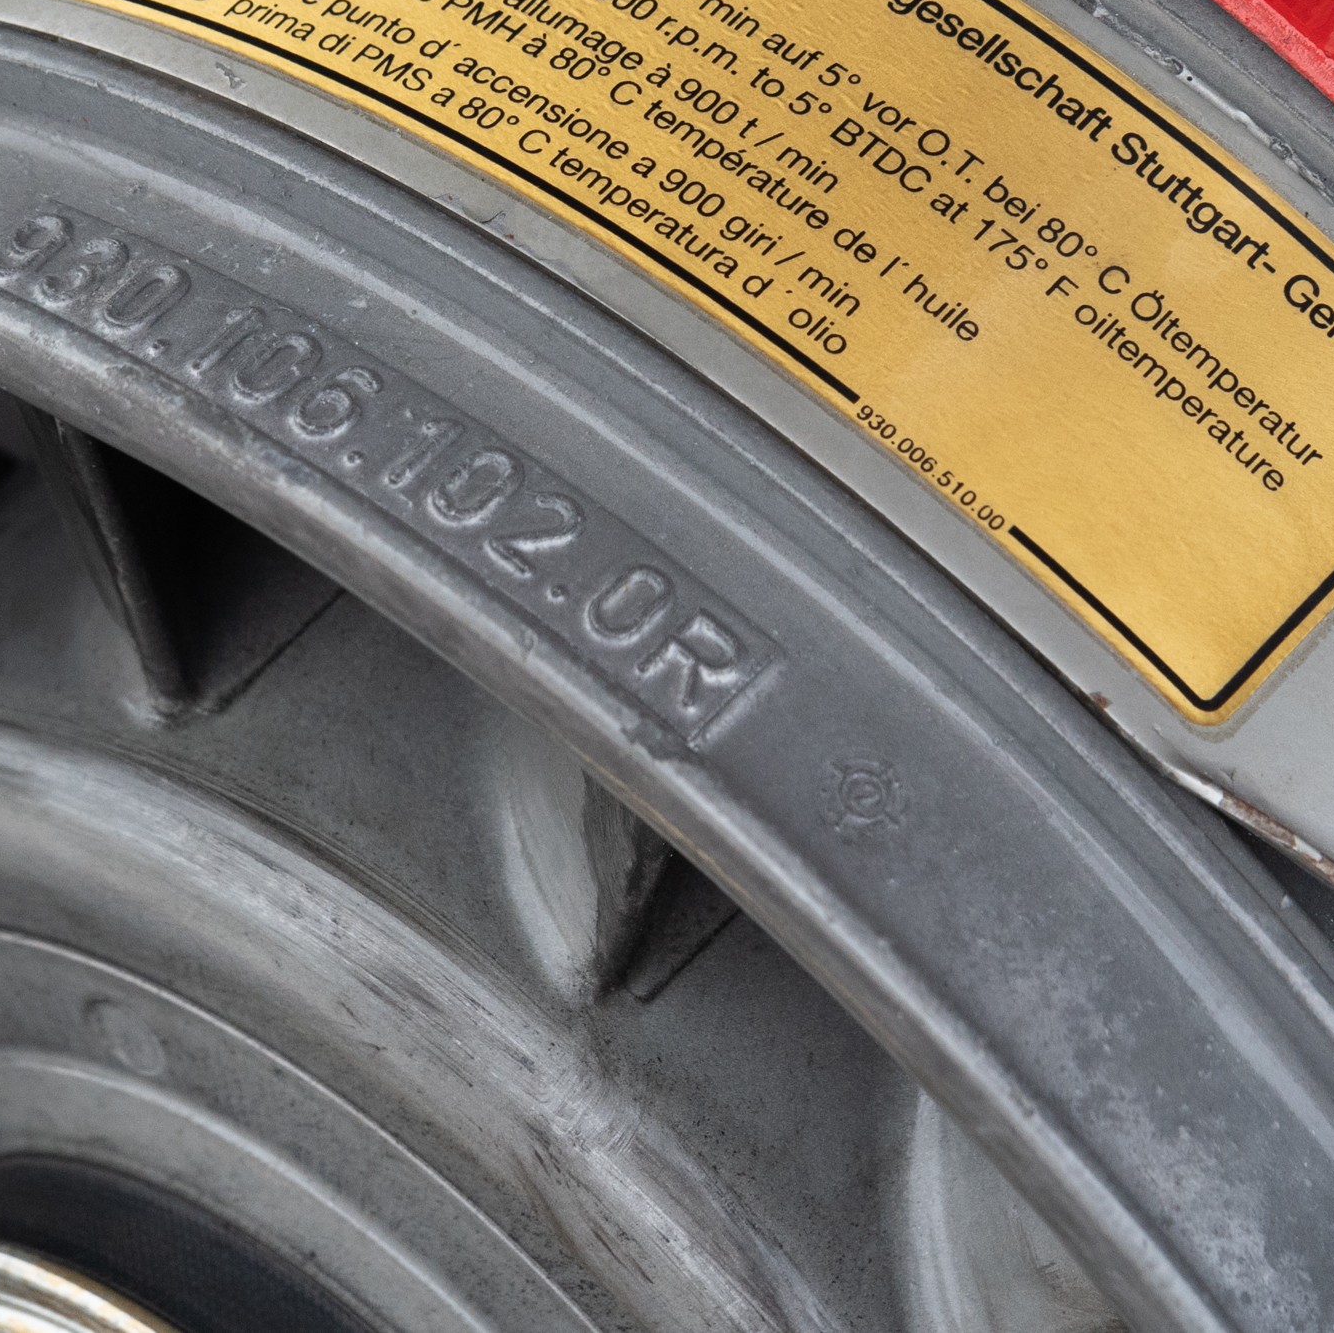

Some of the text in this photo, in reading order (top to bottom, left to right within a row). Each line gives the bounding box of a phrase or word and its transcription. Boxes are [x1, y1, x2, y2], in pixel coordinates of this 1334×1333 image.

[318, 33, 357, 56] di
[351, 43, 433, 92] PMS
[430, 87, 456, 108] a
[518, 129, 551, 155] C
[549, 147, 739, 279] temperatura
[787, 308, 848, 355] olio
[452, 57, 630, 160] accensione
[630, 156, 657, 179] a
[658, 168, 726, 218] 900
[719, 215, 783, 257] giri
[773, 250, 806, 266] /
[797, 266, 861, 317] min
[521, 32, 548, 59] à
[609, 80, 643, 106] C
[643, 99, 830, 230] température
[833, 228, 877, 264] de
[902, 273, 980, 342] huile
[645, 62, 672, 89] à
[673, 78, 740, 125] 900
[738, 117, 759, 139] t
[753, 132, 785, 148] /
[775, 146, 839, 194] min
[655, 15, 738, 76] r.p.m.
[749, 66, 785, 98] to
[829, 117, 932, 193] BTDC
[929, 193, 969, 225] at
[1045, 274, 1080, 297] F
[1074, 304, 1285, 492] oiltemperature
[761, 33, 825, 71] auf
[862, 91, 918, 133] vor
[917, 128, 985, 184] O.T.
[982, 174, 1041, 225] bei
[1098, 265, 1131, 295] C
[1130, 289, 1323, 466] Öltemperatur
[856, 404, 1005, 531] 930.006.510.00
